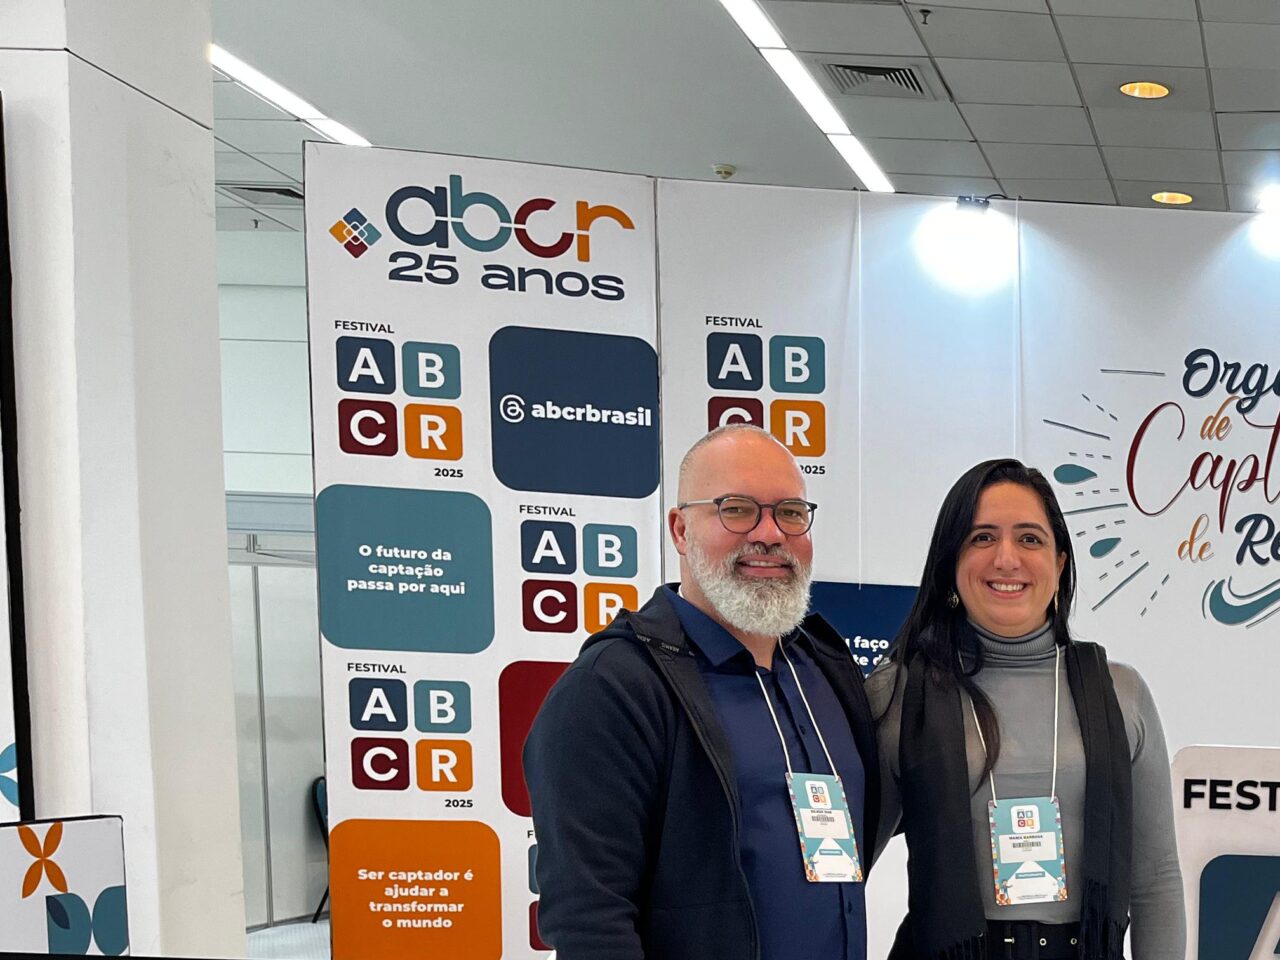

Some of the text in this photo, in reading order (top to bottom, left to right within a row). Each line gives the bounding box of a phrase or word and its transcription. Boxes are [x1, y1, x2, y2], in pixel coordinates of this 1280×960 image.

[385, 174, 635, 262] abcr
[388, 251, 625, 301] 25 anos
[334, 319, 395, 334] FESTIVAL
[705, 315, 763, 328] FESTIVAL
[348, 347, 445, 389] A B
[718, 343, 810, 383] A B
[1200, 395, 1241, 441] de
[350, 409, 447, 451] C R
[785, 410, 811, 447] R
[434, 468, 463, 478] 2025
[519, 504, 576, 517] FESTIVAL
[1177, 514, 1214, 562] de
[359, 545, 452, 560] O futuro da
[532, 530, 623, 568] A B
[368, 564, 444, 579] captação
[347, 579, 465, 596] passa por aqui
[532, 588, 624, 626] C R
[853, 635, 889, 652] faço
[347, 662, 407, 675] FESTIVAL
[361, 687, 456, 724] A B
[362, 746, 458, 783] C R
[445, 798, 474, 809] 2025
[358, 869, 474, 883] Ser captador é
[384, 884, 449, 899] ajudar a
[369, 901, 464, 912] transformar
[382, 916, 453, 928] o mundo
